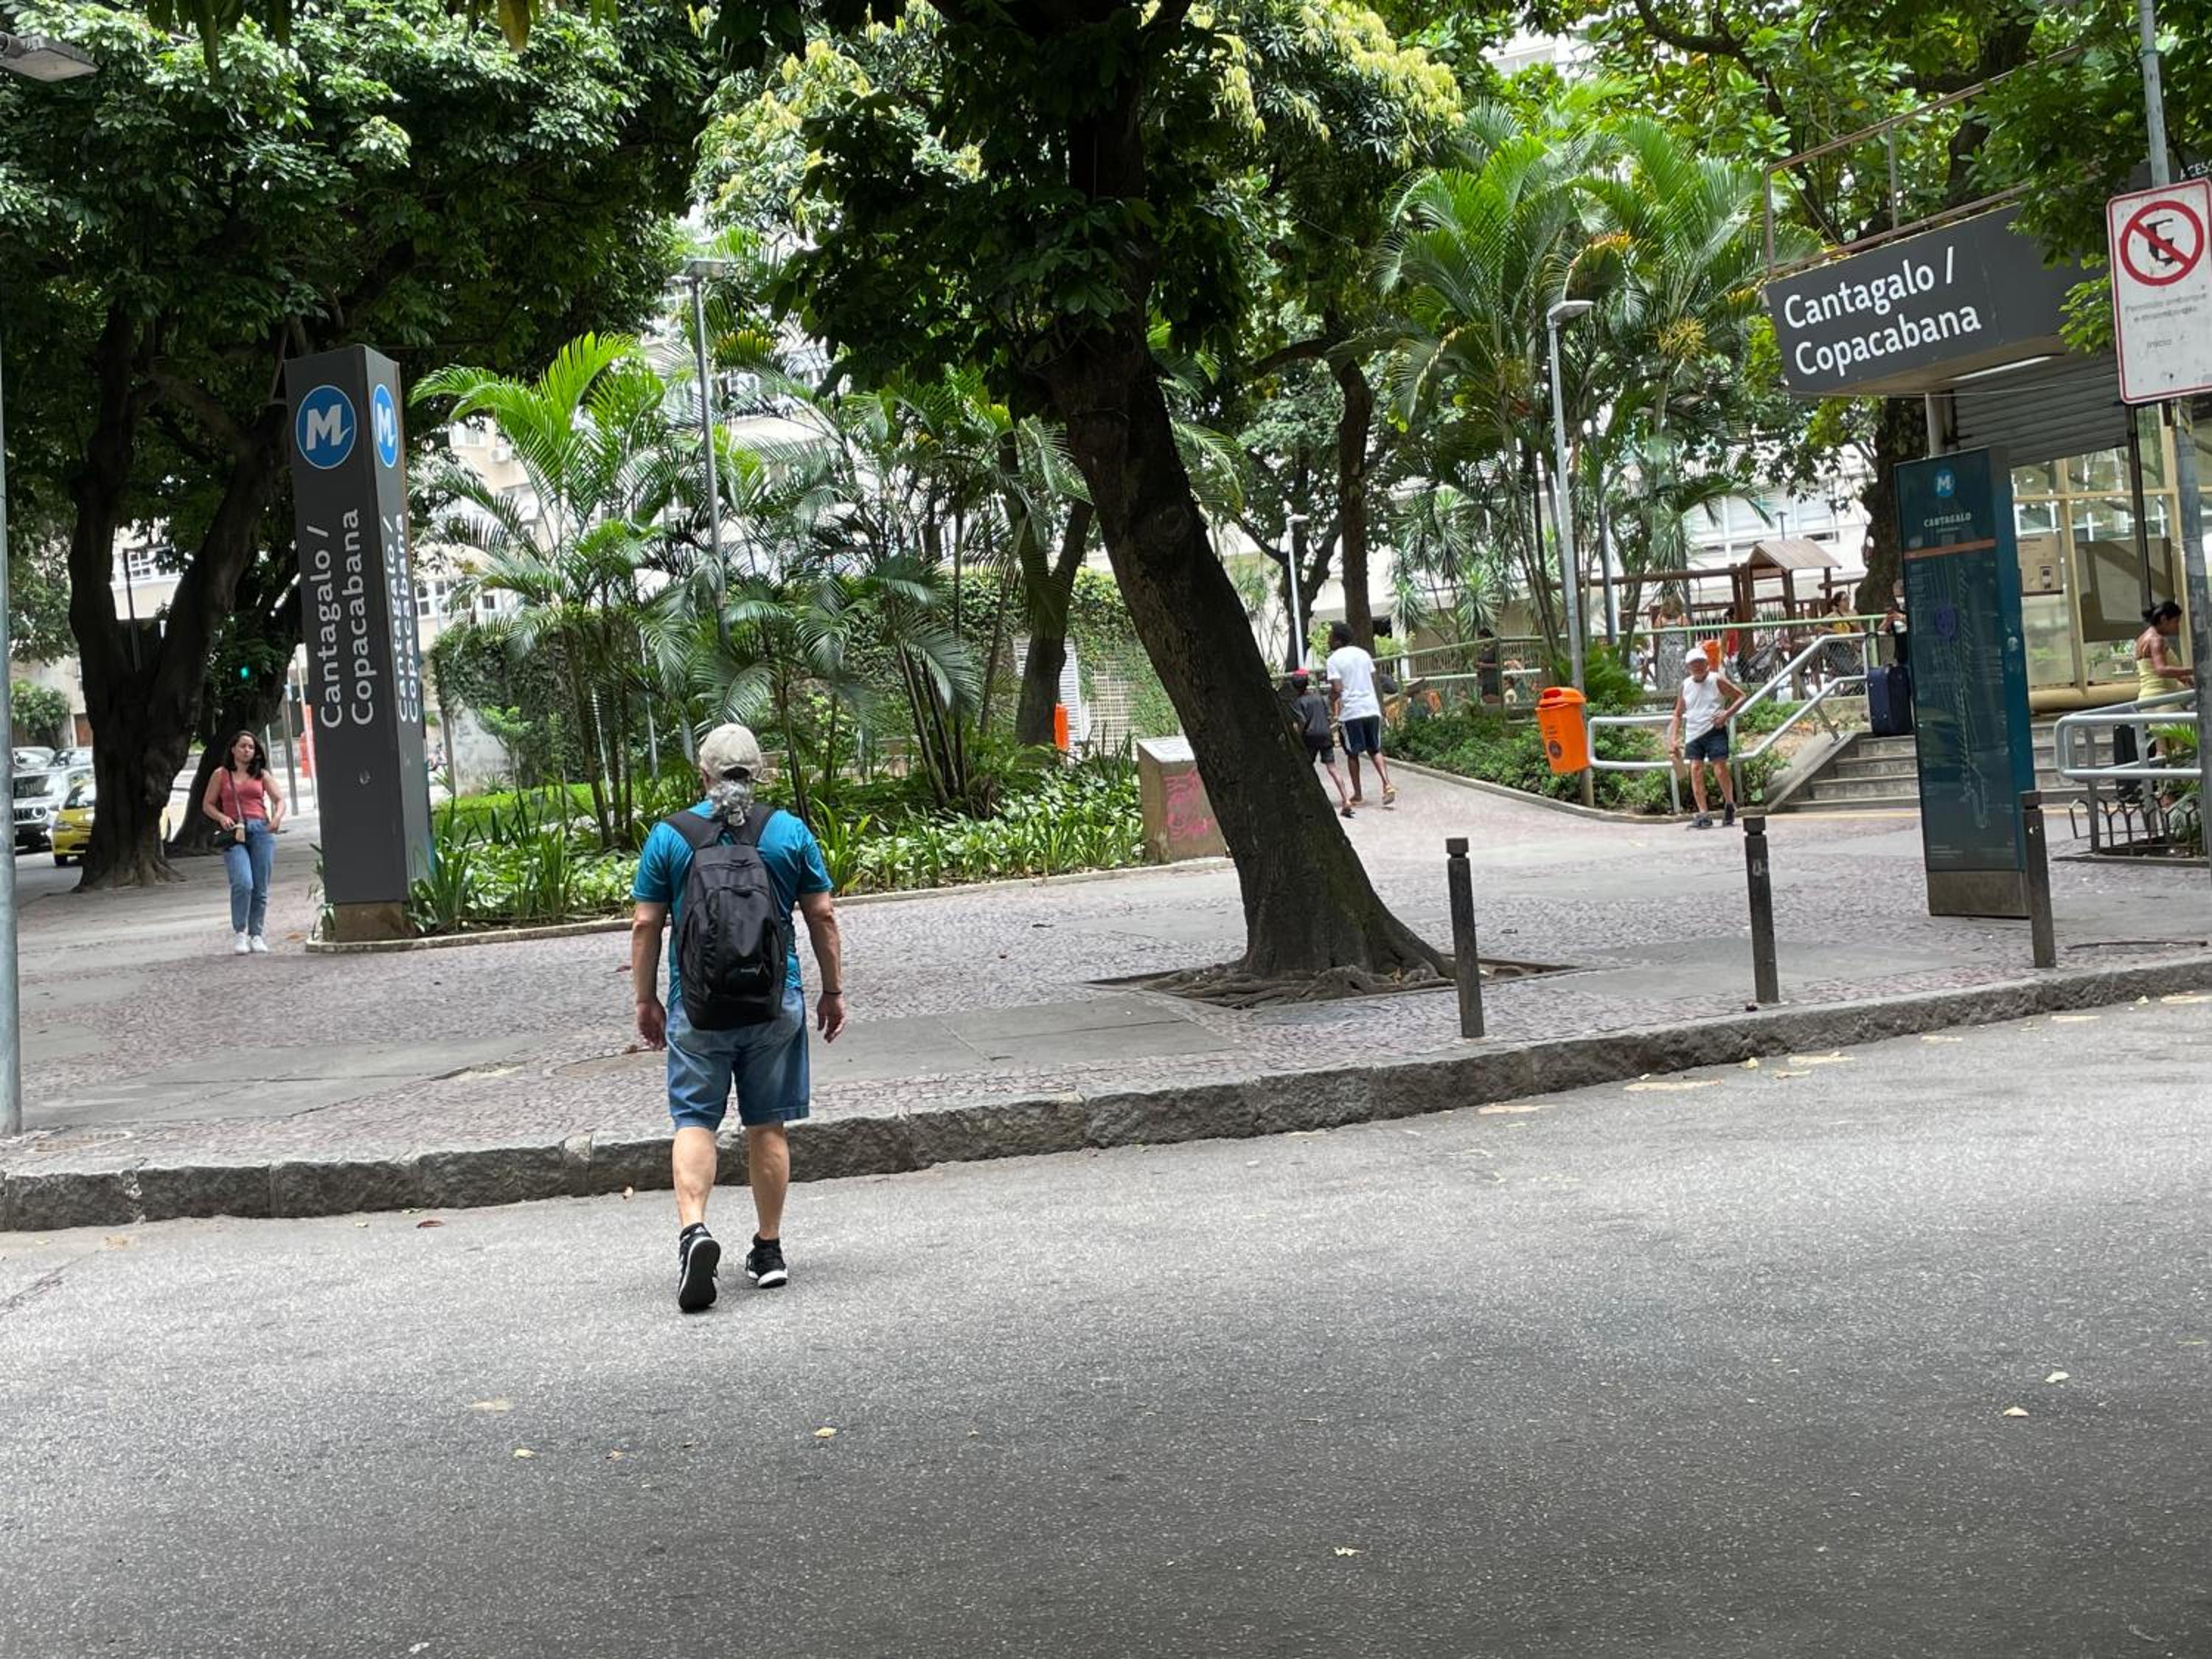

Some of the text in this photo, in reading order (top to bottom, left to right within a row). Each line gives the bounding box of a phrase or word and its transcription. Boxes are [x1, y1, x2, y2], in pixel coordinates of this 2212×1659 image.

[1784, 246, 1954, 328] Cantagalo /
[1795, 306, 1982, 377] Copacabana
[307, 403, 352, 451] M
[1924, 512, 1971, 527] CANTAGALO
[306, 525, 343, 728] Cantagalo /
[341, 509, 378, 725] Copacabana
[383, 516, 409, 722] Cantagalo /
[396, 514, 418, 723] Copacabana
